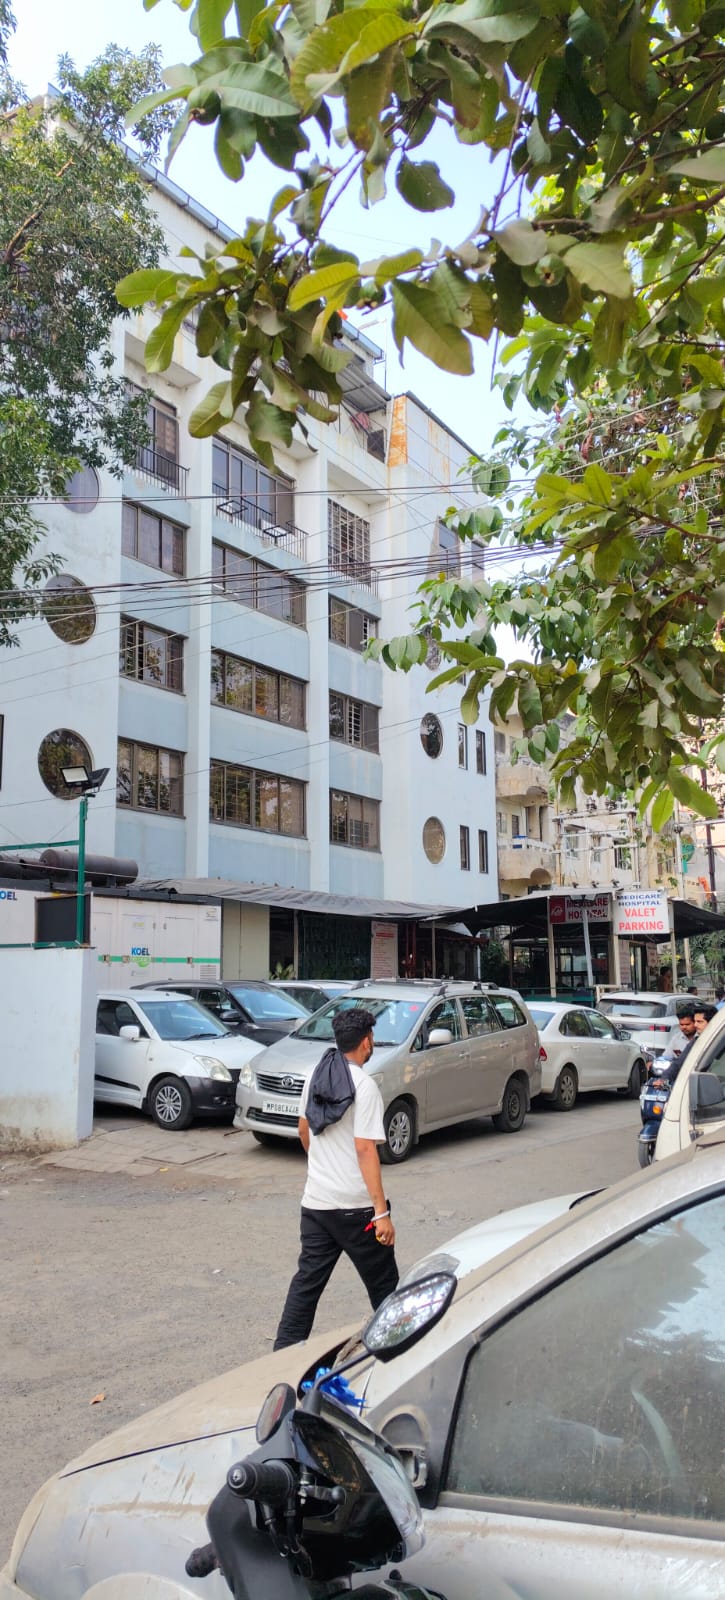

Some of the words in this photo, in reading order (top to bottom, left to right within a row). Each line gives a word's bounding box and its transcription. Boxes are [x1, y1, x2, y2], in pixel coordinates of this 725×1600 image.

[624, 907, 657, 918] VALET
[618, 920, 664, 931] PARKING
[131, 947, 150, 956] KOEL
